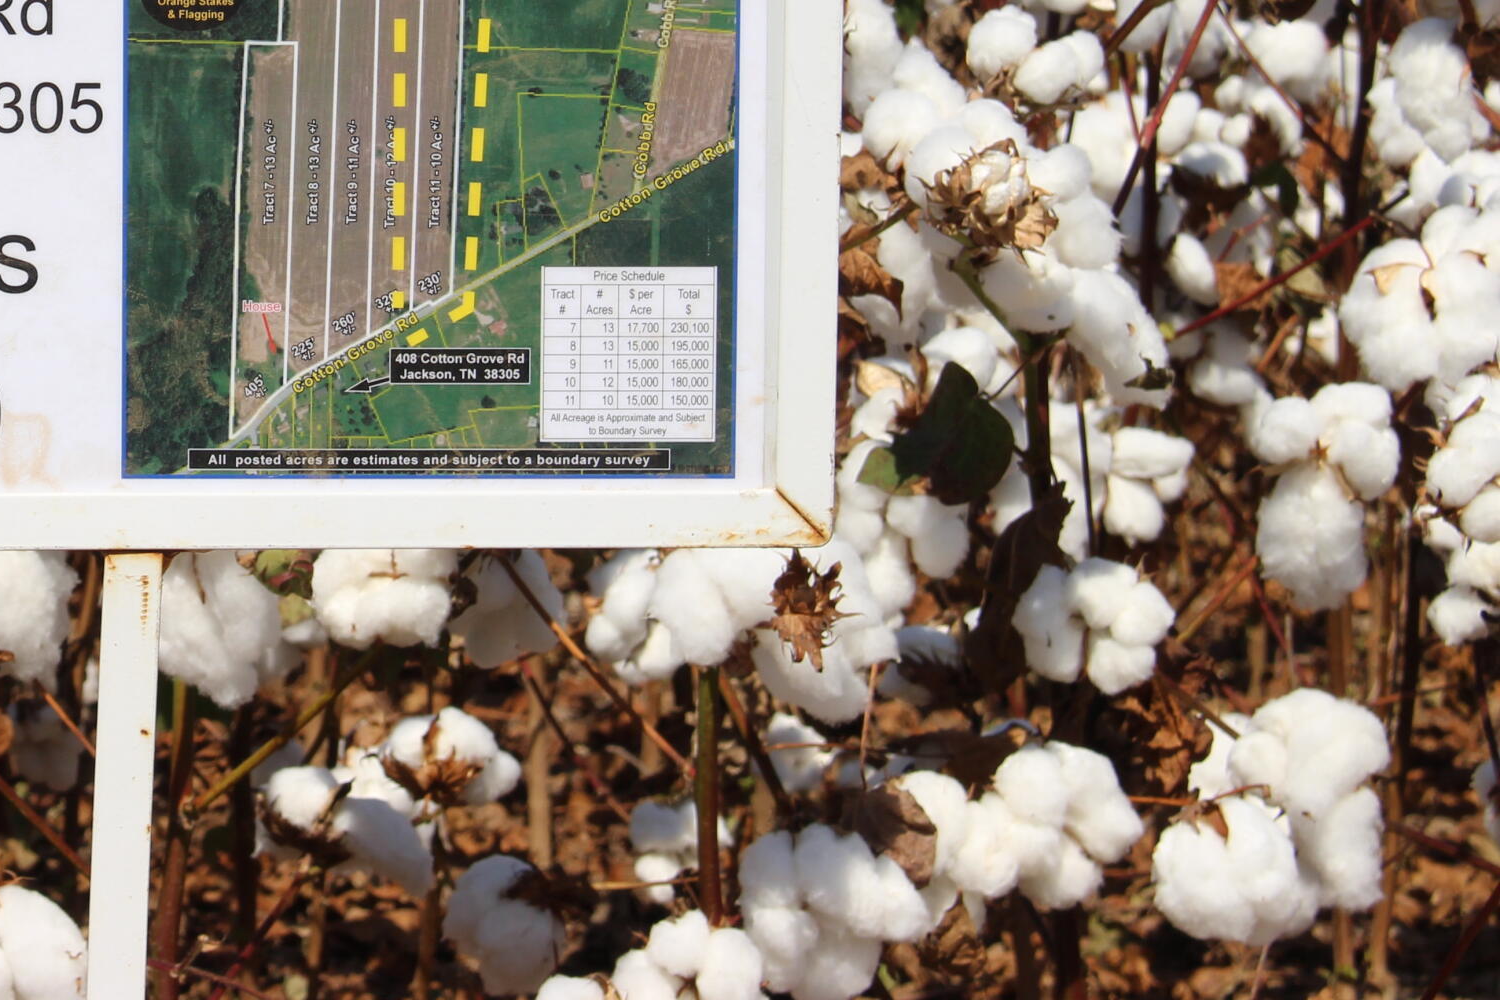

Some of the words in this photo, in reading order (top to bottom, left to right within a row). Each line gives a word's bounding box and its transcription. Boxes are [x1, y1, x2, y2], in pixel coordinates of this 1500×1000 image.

[167, 9, 176, 19] &
[178, 9, 225, 21] Flagging
[657, 11, 675, 48] Cobb
[641, 101, 657, 126] Rd
[265, 136, 277, 154] Ac
[309, 136, 321, 154] Ac
[348, 136, 360, 154] Ac
[431, 132, 443, 150] Ac
[634, 126, 653, 174] Cobb
[264, 156, 276, 170] 13
[308, 156, 320, 170] 13
[347, 157, 360, 170] 11
[431, 153, 442, 168] 10
[264, 182, 275, 190] 7
[307, 182, 319, 190] 8
[346, 182, 358, 190] 9
[429, 180, 441, 194] 11
[599, 187, 652, 223] Cotton
[654, 159, 700, 190] Grove
[702, 140, 726, 161] Rd
[263, 192, 275, 225] Tract
[307, 192, 319, 225] Tract
[345, 192, 357, 225] Tract
[428, 196, 441, 229] Tract
[417, 270, 442, 291] 230'
[593, 270, 618, 281] Price
[620, 270, 666, 281] Schedule
[550, 288, 575, 299] Tract
[596, 289, 603, 299] #
[628, 288, 636, 300] $
[637, 290, 654, 301] per
[677, 288, 701, 299] Total
[242, 299, 282, 312] House
[559, 304, 566, 315] #
[586, 304, 614, 315] Acres
[629, 304, 653, 315] Acre
[685, 303, 692, 315] $
[331, 311, 356, 332] 260'
[570, 322, 576, 333] 7
[603, 322, 614, 333] 13
[627, 322, 659, 334] 17,700
[671, 322, 709, 334] 230,100
[291, 336, 315, 357] 225'
[292, 357, 345, 393] Cotton
[347, 329, 394, 361] Grove
[396, 312, 419, 332] Rd
[570, 340, 576, 351] 8
[603, 340, 614, 351] 13
[627, 340, 659, 352] 15,000
[671, 340, 709, 352] 195,000
[395, 353, 417, 364] 408
[420, 353, 463, 364] Cotton
[466, 353, 504, 364] Grove
[507, 353, 525, 364] Rd
[569, 358, 576, 369] 9
[603, 358, 614, 369] 11
[627, 358, 659, 370] 15,000
[671, 358, 709, 370] 165,000
[400, 369, 456, 381] Jackson,
[459, 368, 477, 379] TN
[484, 368, 520, 379] 38305
[564, 376, 576, 387] 10
[602, 376, 614, 387] 12
[627, 376, 659, 388] 15,000
[671, 376, 709, 388] 180,000
[565, 395, 576, 405] 11
[602, 395, 614, 405] 10
[627, 395, 659, 406] 15,000
[671, 395, 709, 406] 150,000
[550, 413, 561, 422] All
[562, 413, 595, 424] Acreage
[597, 413, 605, 422] is
[606, 413, 656, 424] Approximate
[658, 413, 674, 422] and
[675, 413, 706, 424] Subject
[588, 426, 597, 435] to
[598, 426, 637, 436] Boundary
[639, 426, 667, 436] Survey
[208, 454, 227, 465] All
[235, 454, 281, 468] posted
[285, 456, 323, 465] acres
[327, 456, 349, 465] are
[352, 454, 419, 465] estimates
[423, 454, 448, 465] and
[452, 454, 503, 468] subject
[507, 455, 520, 465] to
[524, 456, 532, 465] a
[536, 454, 600, 468] boundary
[605, 456, 651, 468] survey
